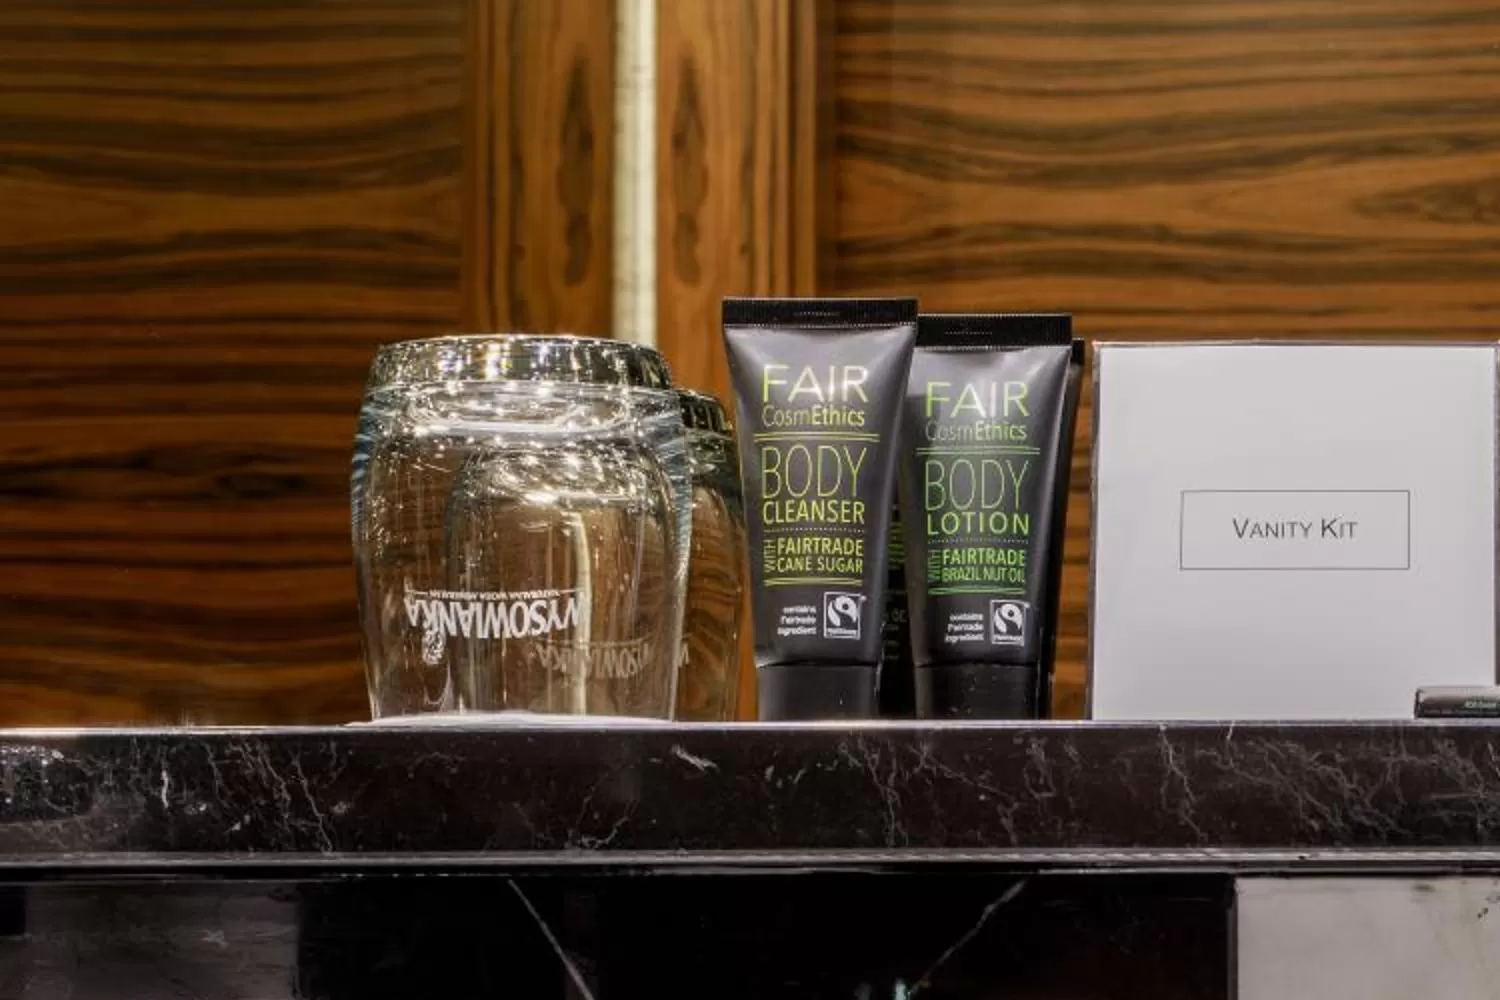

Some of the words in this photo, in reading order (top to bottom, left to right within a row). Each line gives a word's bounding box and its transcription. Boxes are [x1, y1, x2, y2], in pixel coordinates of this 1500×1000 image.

[763, 364, 869, 403] FAIR
[925, 381, 1030, 418] FAIR
[762, 404, 865, 427] CosmEthics
[925, 419, 1027, 442] CosmEthics
[762, 444, 867, 499] BODY
[925, 458, 1029, 512] BODY
[763, 499, 865, 525] CLEANSER
[927, 511, 1030, 536] LOTION
[777, 537, 864, 557] FAIRTRADE
[943, 548, 1026, 567] FAIRTRADE
[777, 556, 813, 573] CANE
[817, 556, 864, 574] SUGAR
[942, 566, 980, 582] BRAZIL
[983, 566, 1008, 582] NUT
[1009, 567, 1026, 584] OIL
